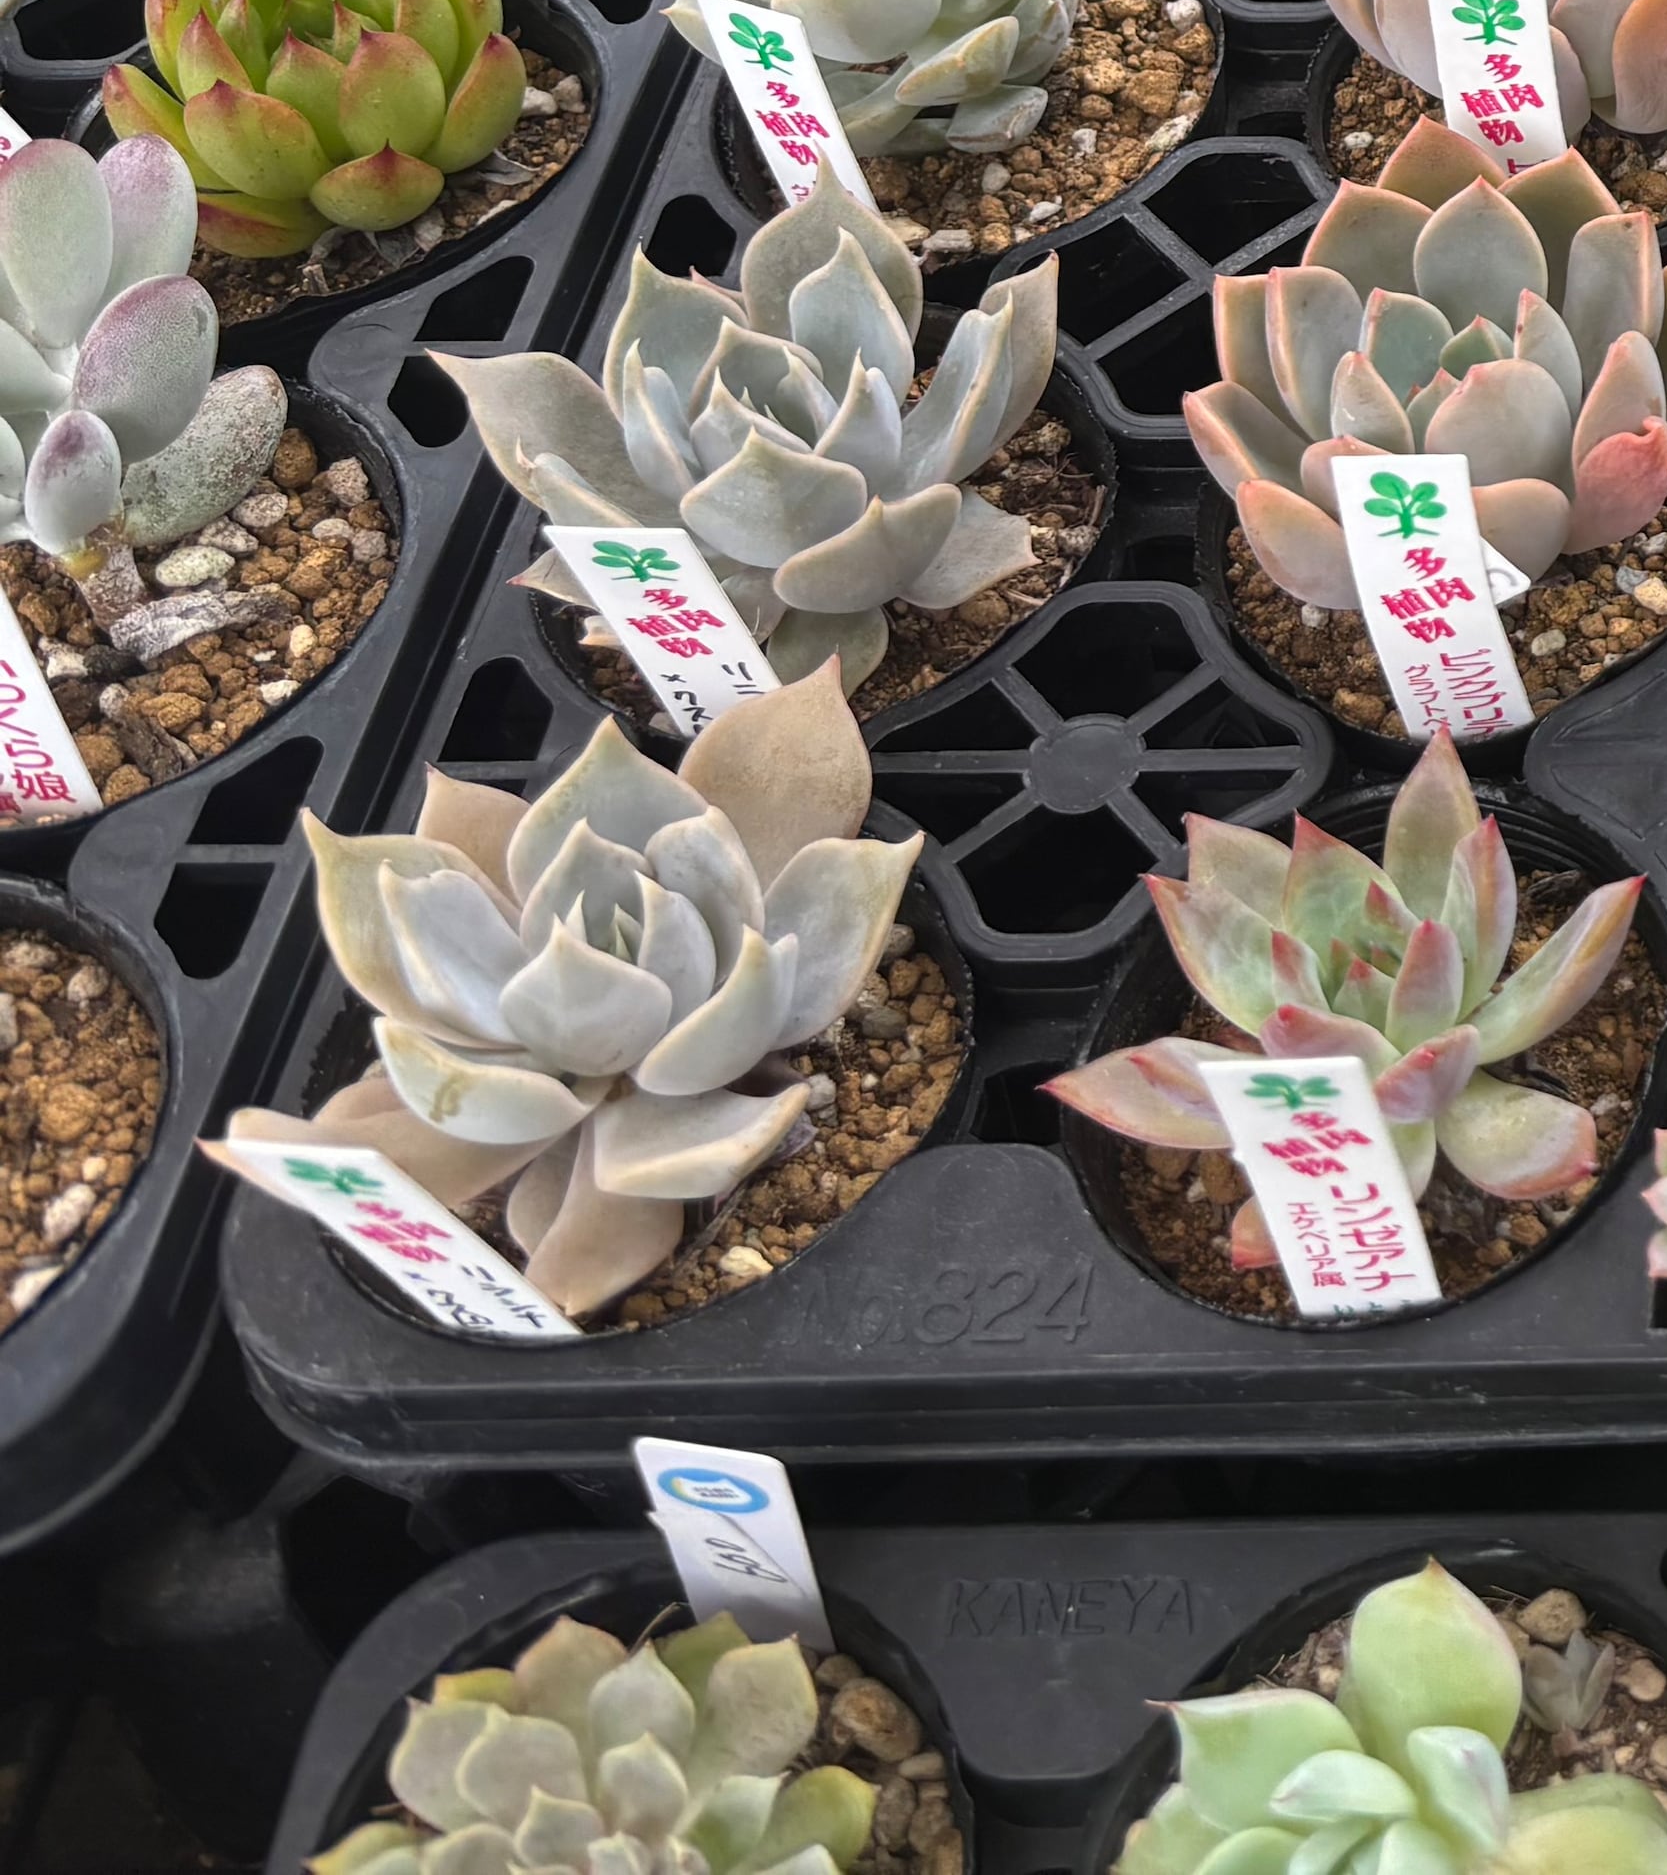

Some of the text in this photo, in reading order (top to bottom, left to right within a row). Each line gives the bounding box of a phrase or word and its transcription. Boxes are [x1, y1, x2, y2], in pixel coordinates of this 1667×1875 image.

[1460, 54, 1545, 147] 多肉植物
[628, 589, 724, 658] 多肉植物
[1381, 548, 1475, 644] 多肉植物
[0, 659, 76, 807] っくら娘
[1264, 1113, 1370, 1177] 多肉植物
[1287, 1202, 1346, 1287] エケベリア属
[946, 1577, 1198, 1640] KANEYA
